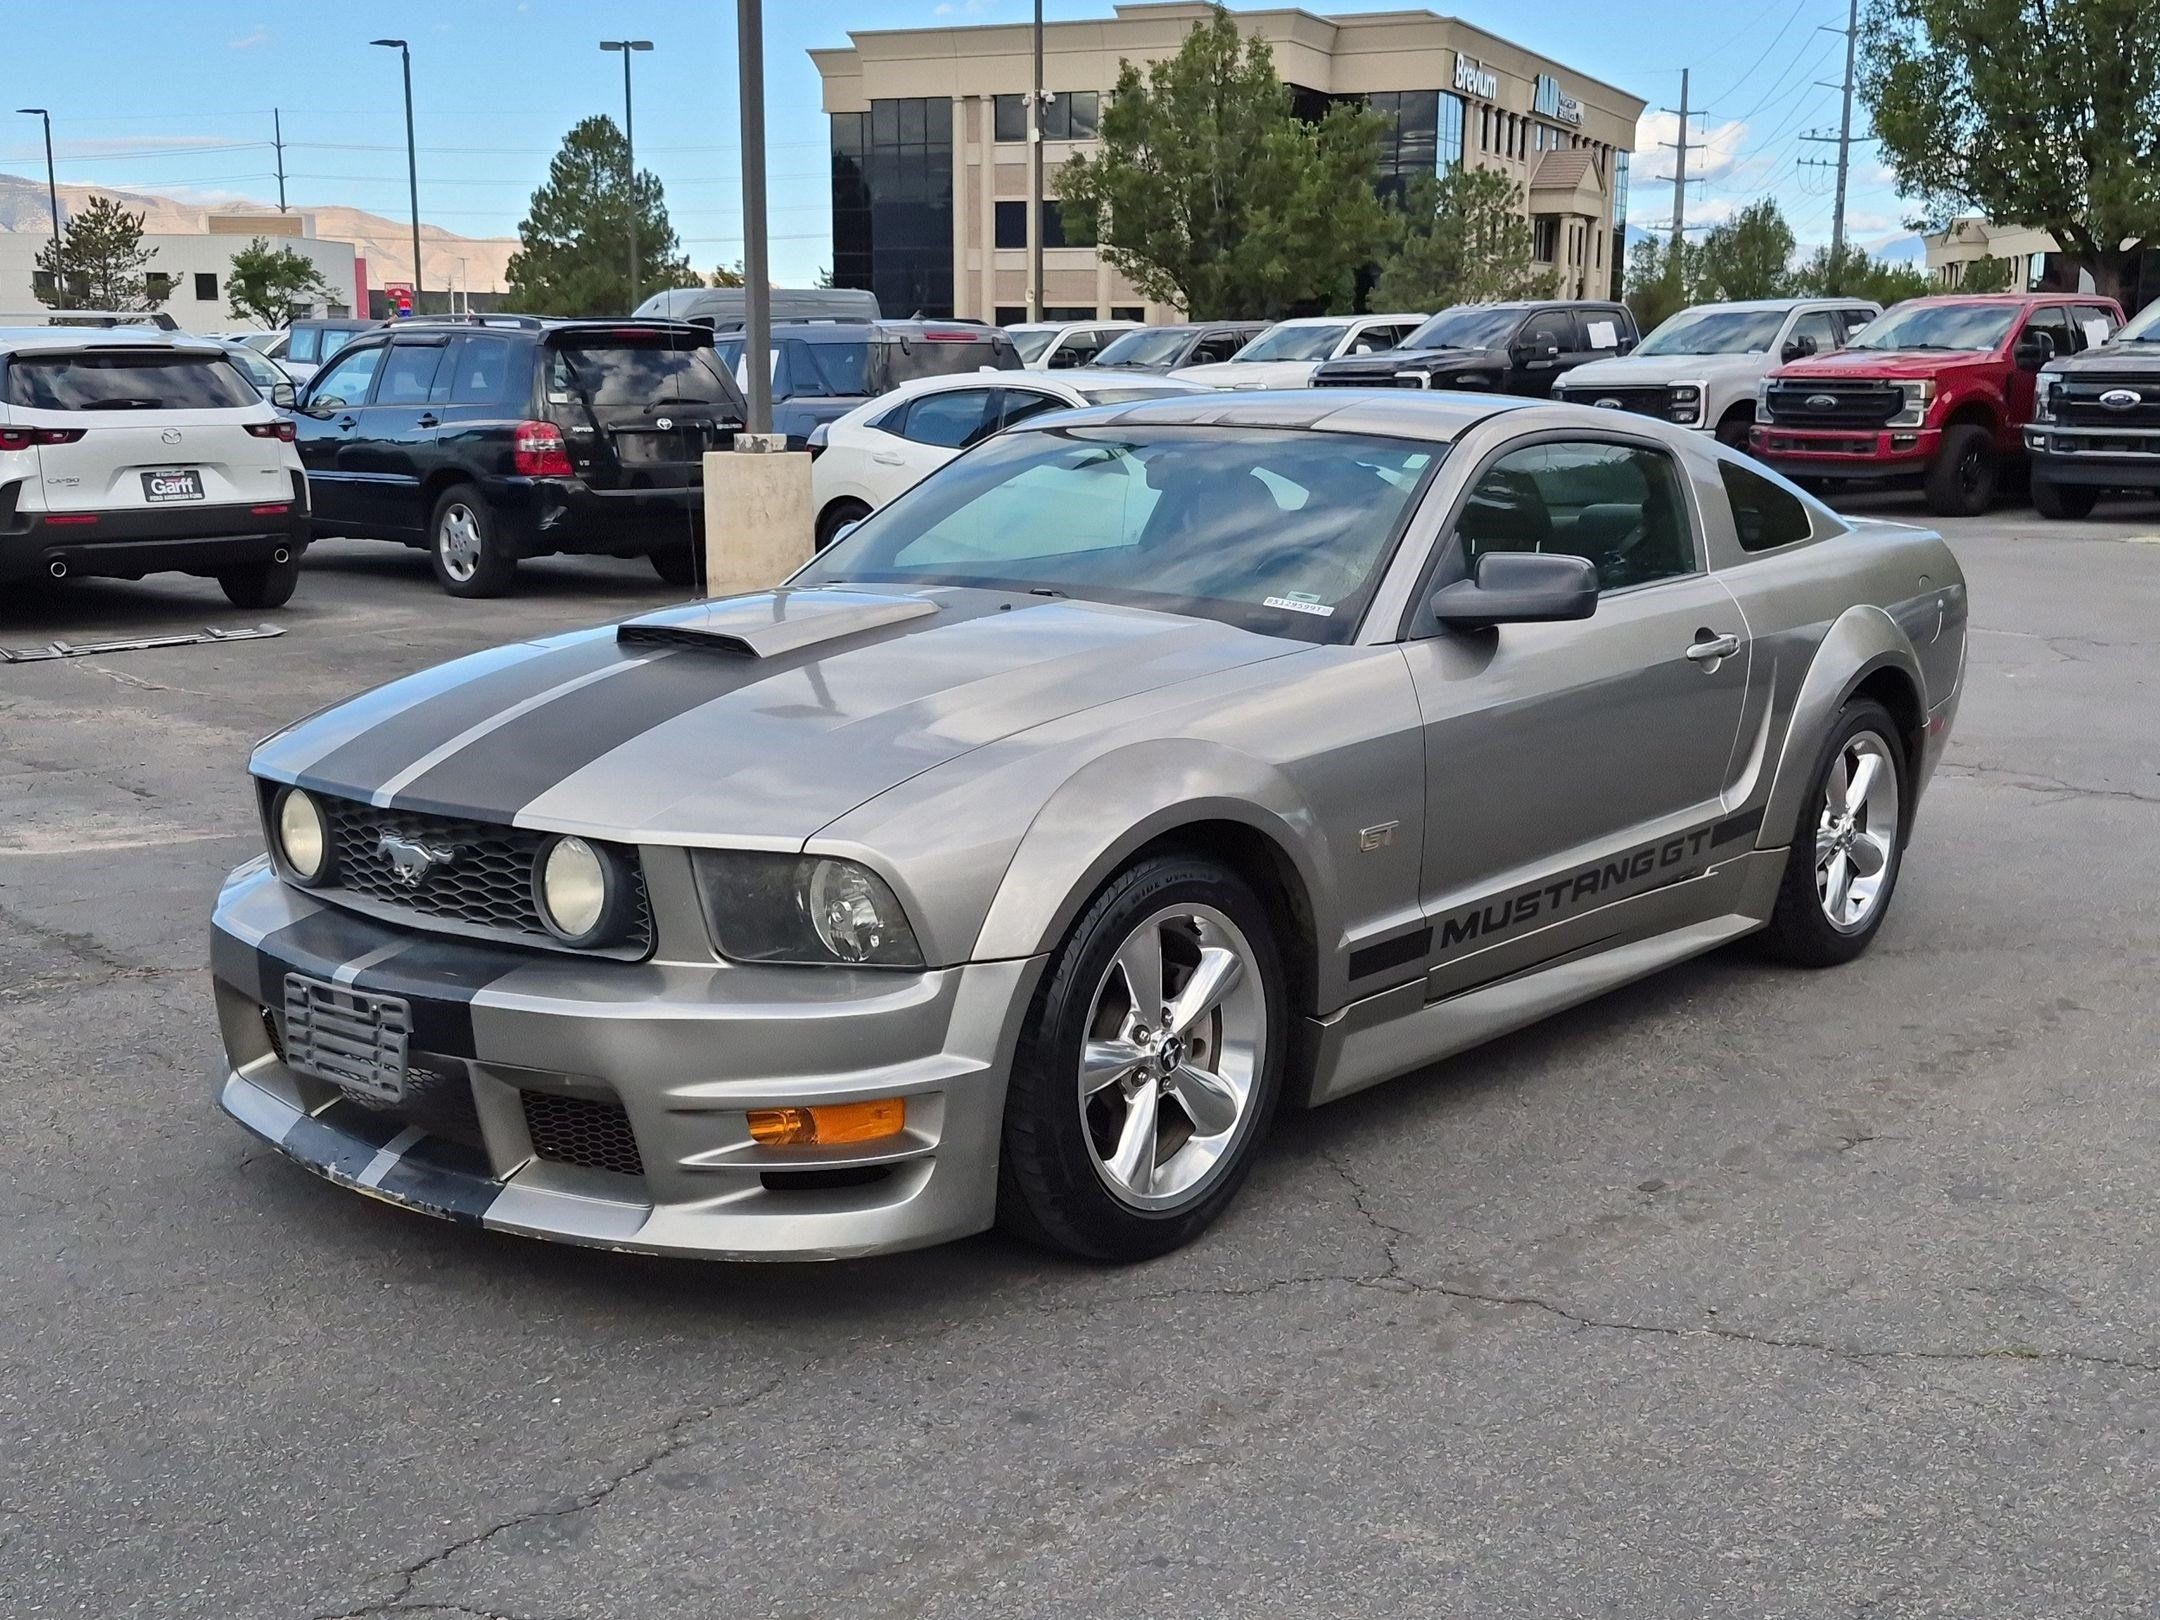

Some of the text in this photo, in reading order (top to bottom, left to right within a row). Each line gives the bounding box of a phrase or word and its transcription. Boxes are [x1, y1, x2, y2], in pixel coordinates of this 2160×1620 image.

[1455, 52, 1497, 101] Brevium
[150, 477, 194, 495] Garff
[1360, 820, 1400, 852] GT
[1440, 826, 1711, 949] MUSTANG GT
